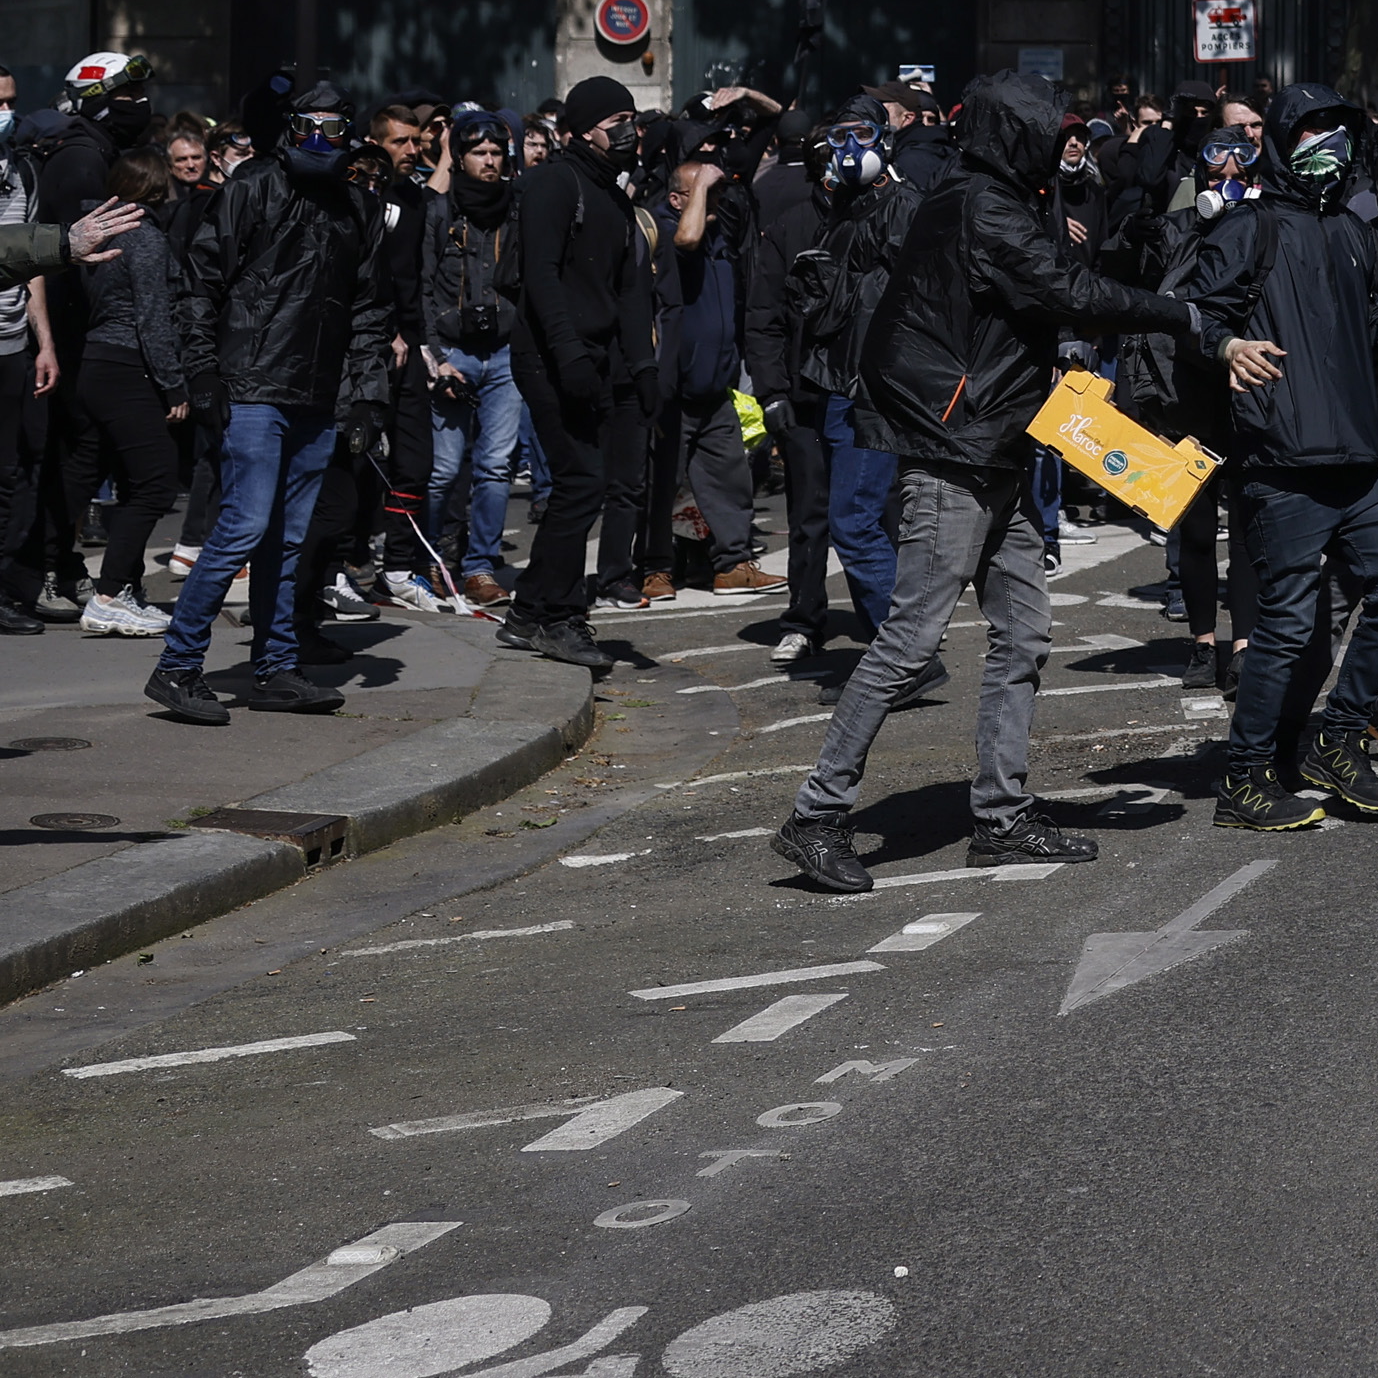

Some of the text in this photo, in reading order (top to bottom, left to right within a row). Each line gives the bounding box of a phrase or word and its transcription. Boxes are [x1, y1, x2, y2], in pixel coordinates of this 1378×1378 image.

[1201, 41, 1252, 51] POMPIERS
[1059, 414, 1103, 456] Maroc
[592, 1056, 920, 1229] MOTO
